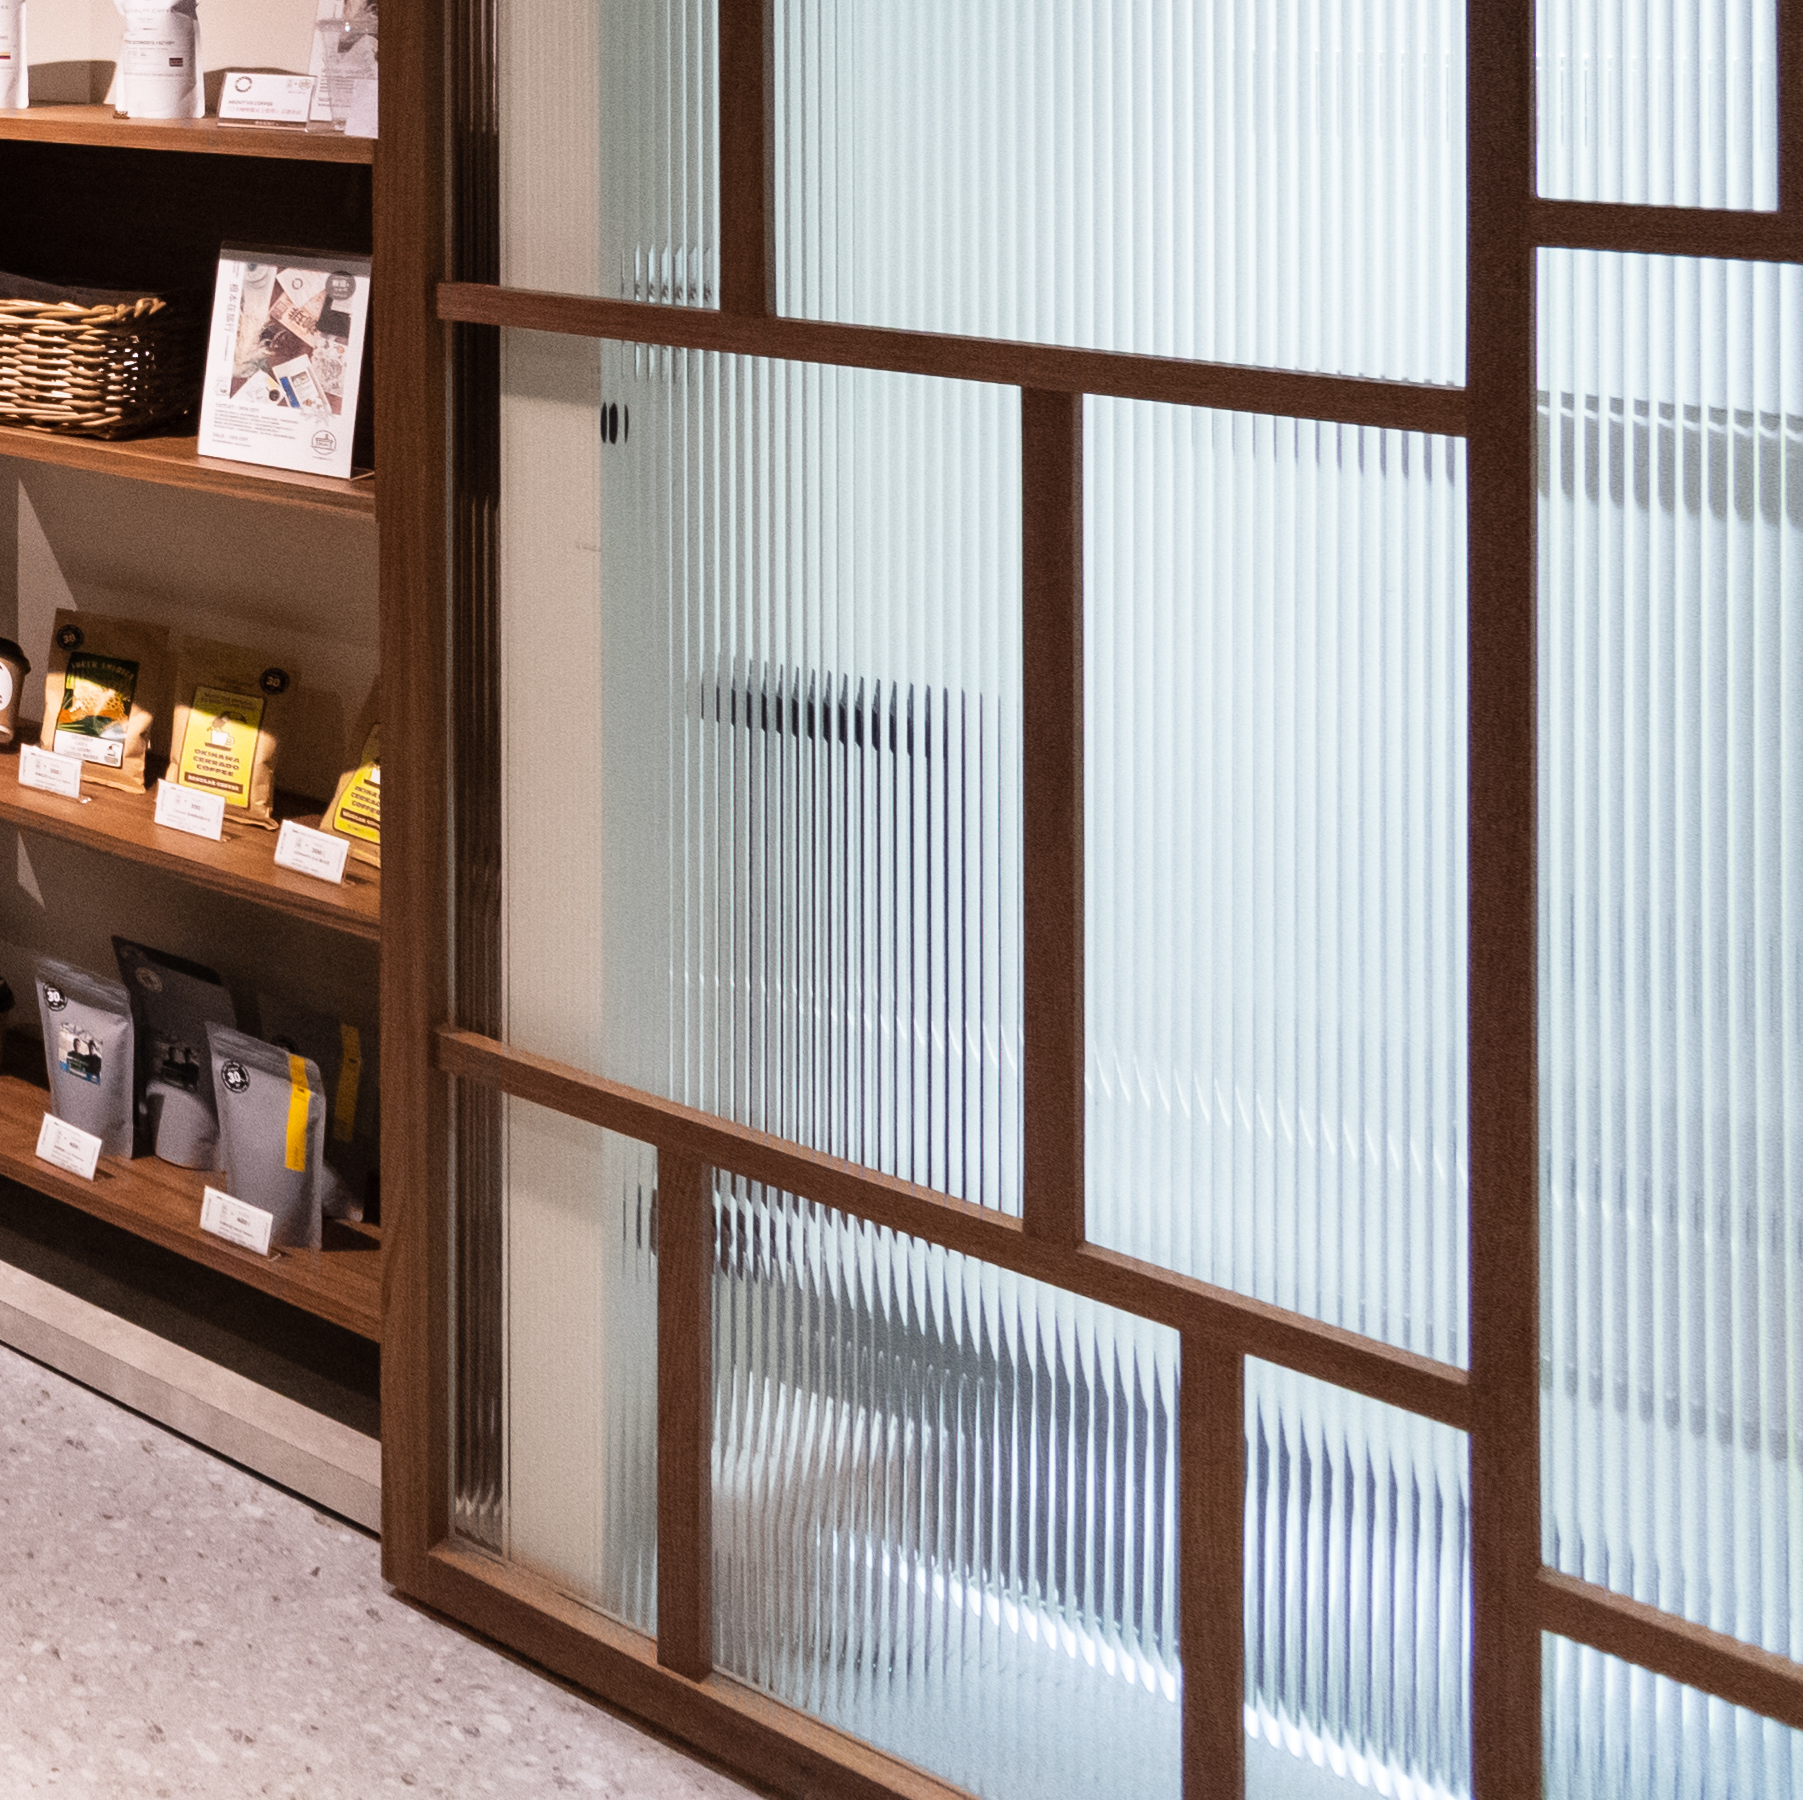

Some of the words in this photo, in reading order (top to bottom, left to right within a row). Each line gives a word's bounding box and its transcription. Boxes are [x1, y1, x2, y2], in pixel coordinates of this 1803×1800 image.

[192, 755, 241, 771] CERRADO
[194, 747, 241, 764] OKINAWA
[196, 763, 235, 777] COFFEE
[226, 1071, 242, 1084] 30
